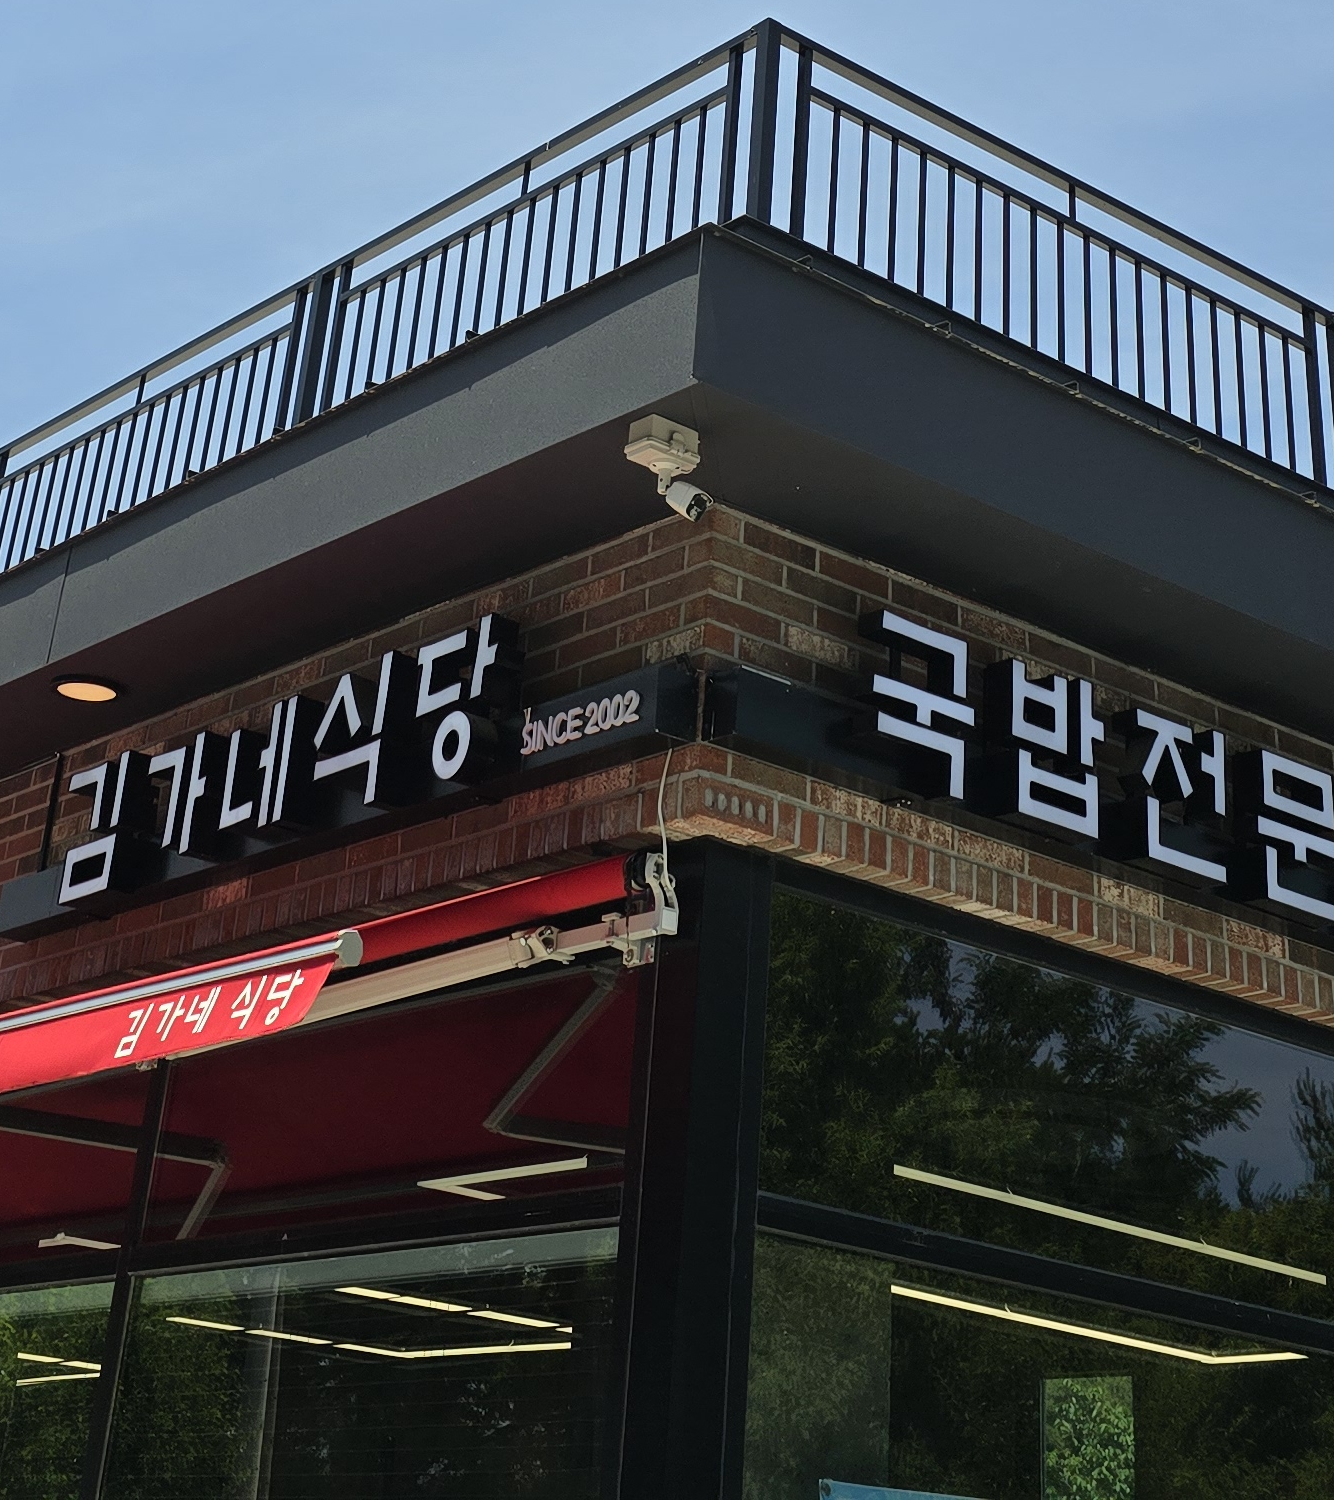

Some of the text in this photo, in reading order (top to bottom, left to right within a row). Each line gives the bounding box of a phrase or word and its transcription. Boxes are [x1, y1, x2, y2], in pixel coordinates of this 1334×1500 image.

[58, 612, 499, 905] 김가네식당
[520, 689, 640, 755] SINCE 2002
[114, 969, 305, 1058] 김가네 식당
